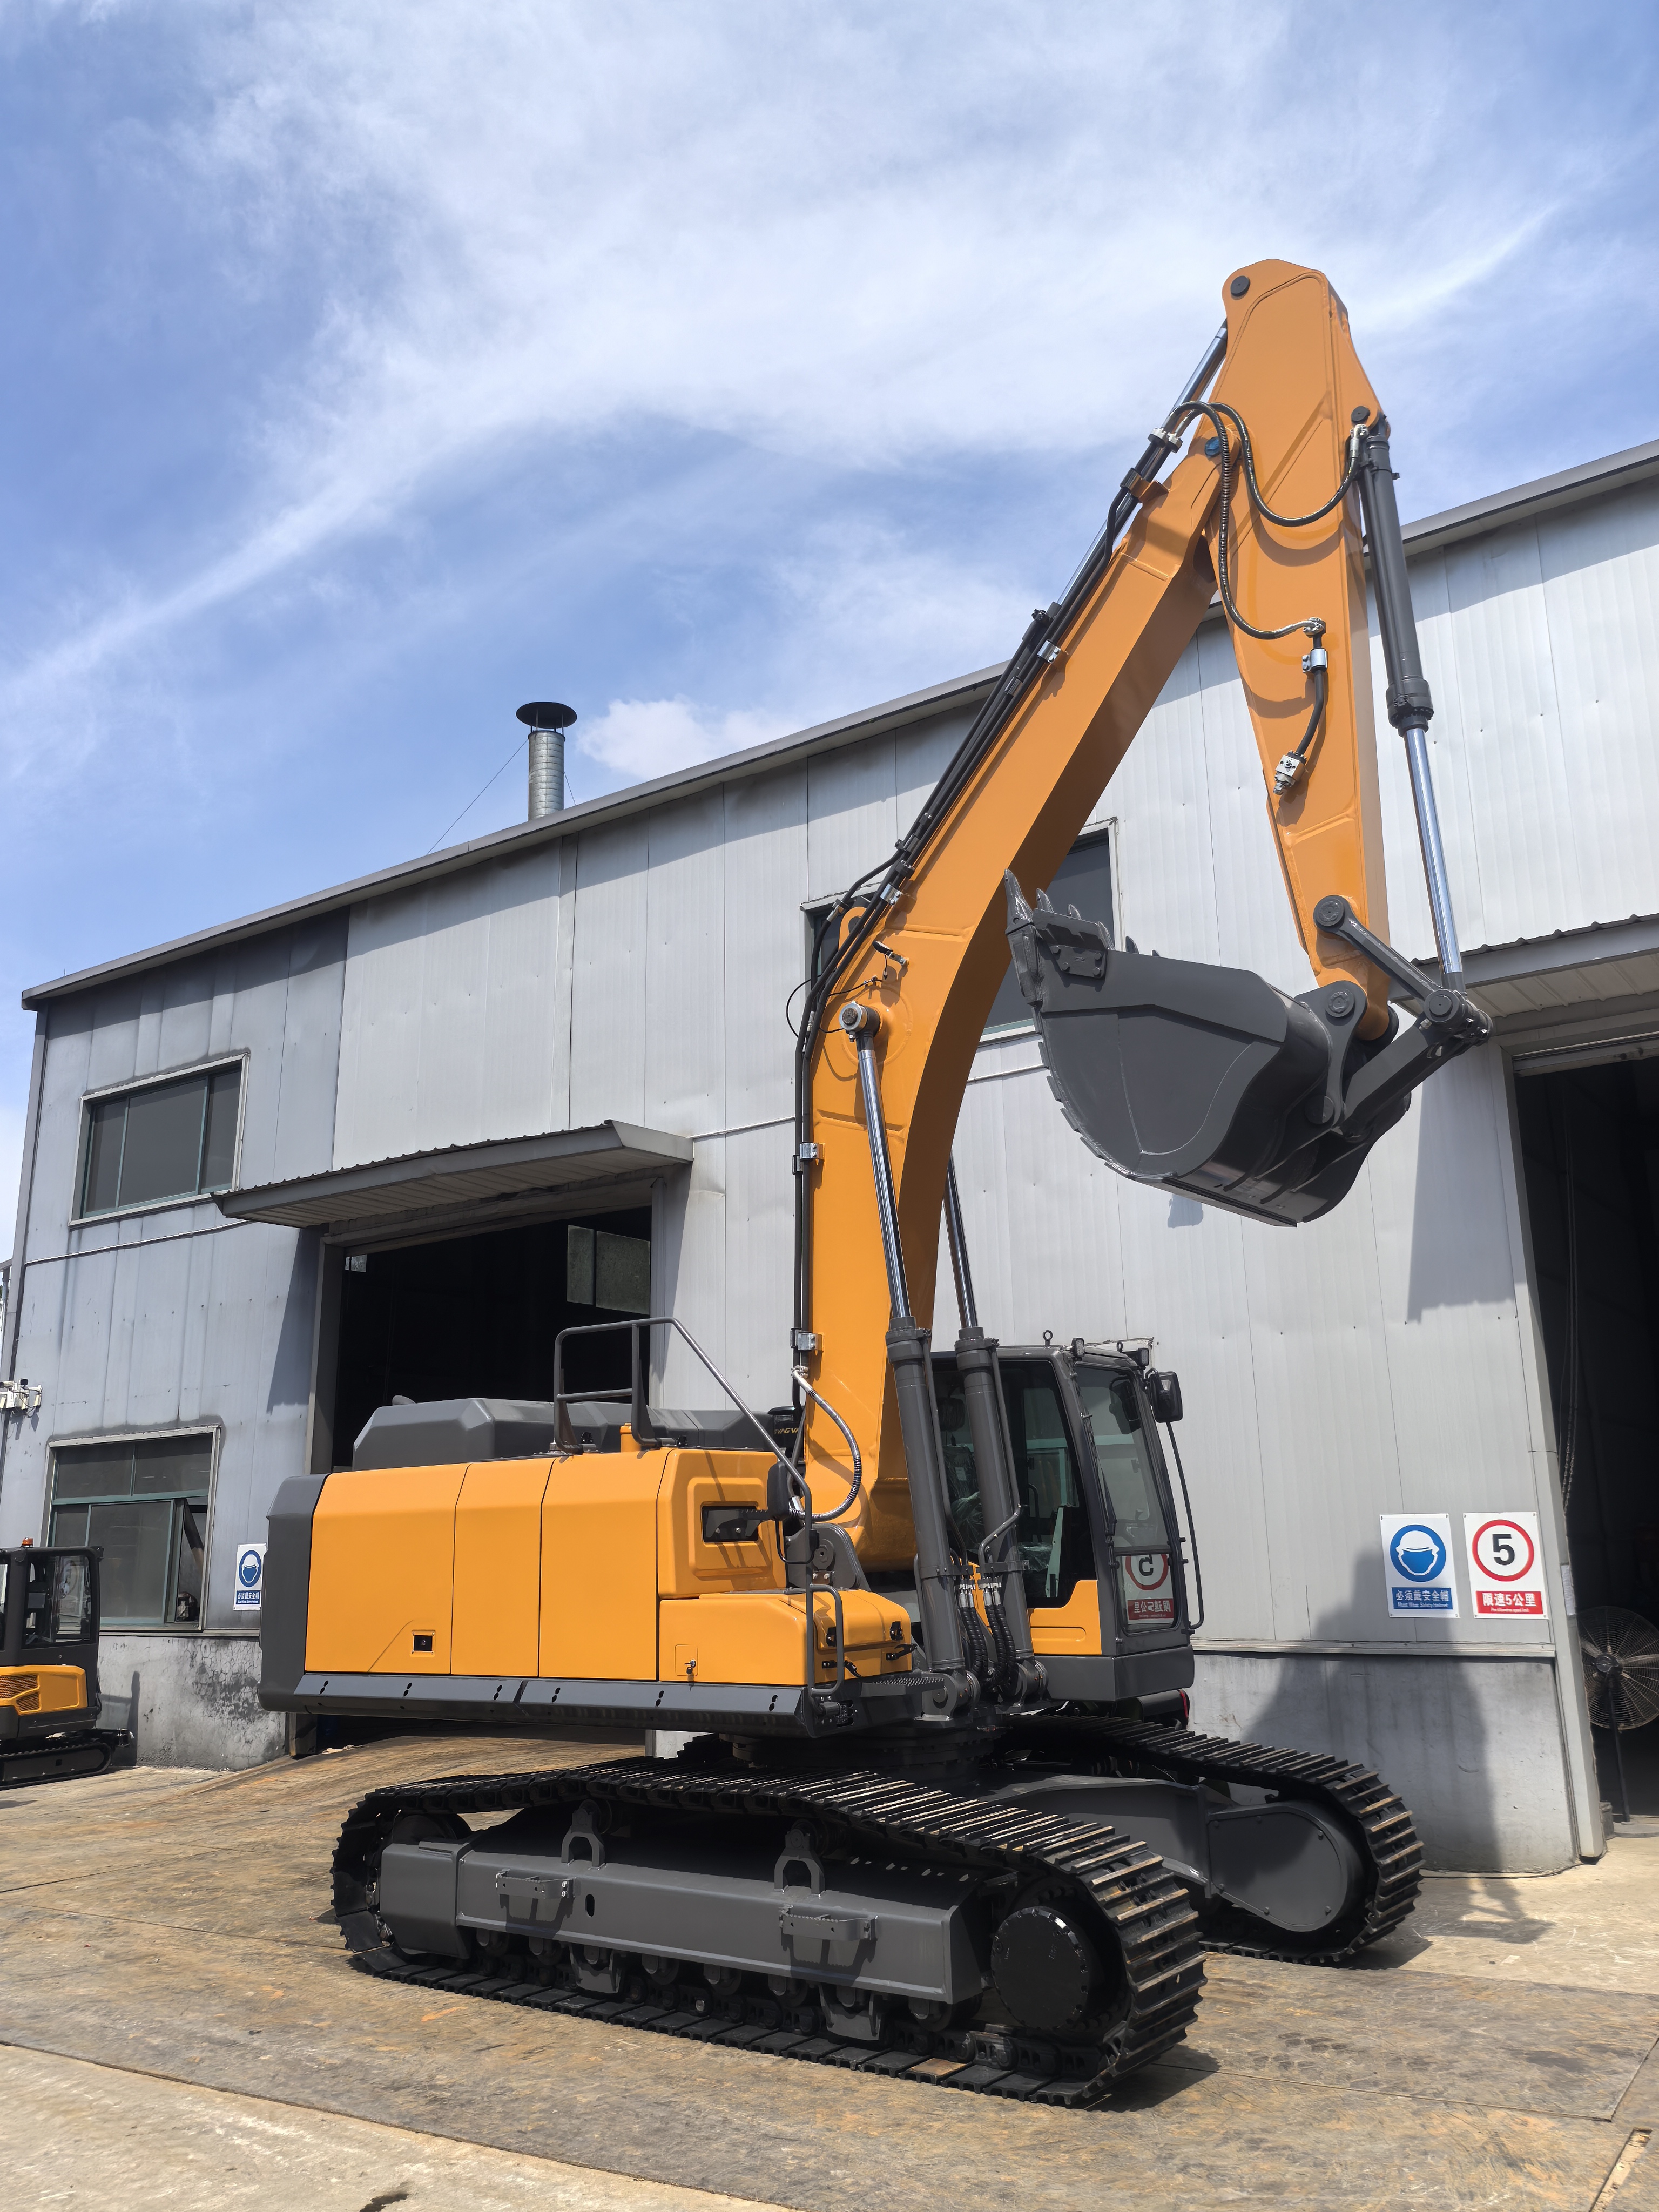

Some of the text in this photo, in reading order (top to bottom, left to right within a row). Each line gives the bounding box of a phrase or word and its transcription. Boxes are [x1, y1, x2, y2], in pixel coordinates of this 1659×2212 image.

[1492, 1534, 1515, 1566] 5
[1396, 1590, 1449, 1601] 必须戴安全帽
[1482, 1593, 1537, 1607] 限速5公里
